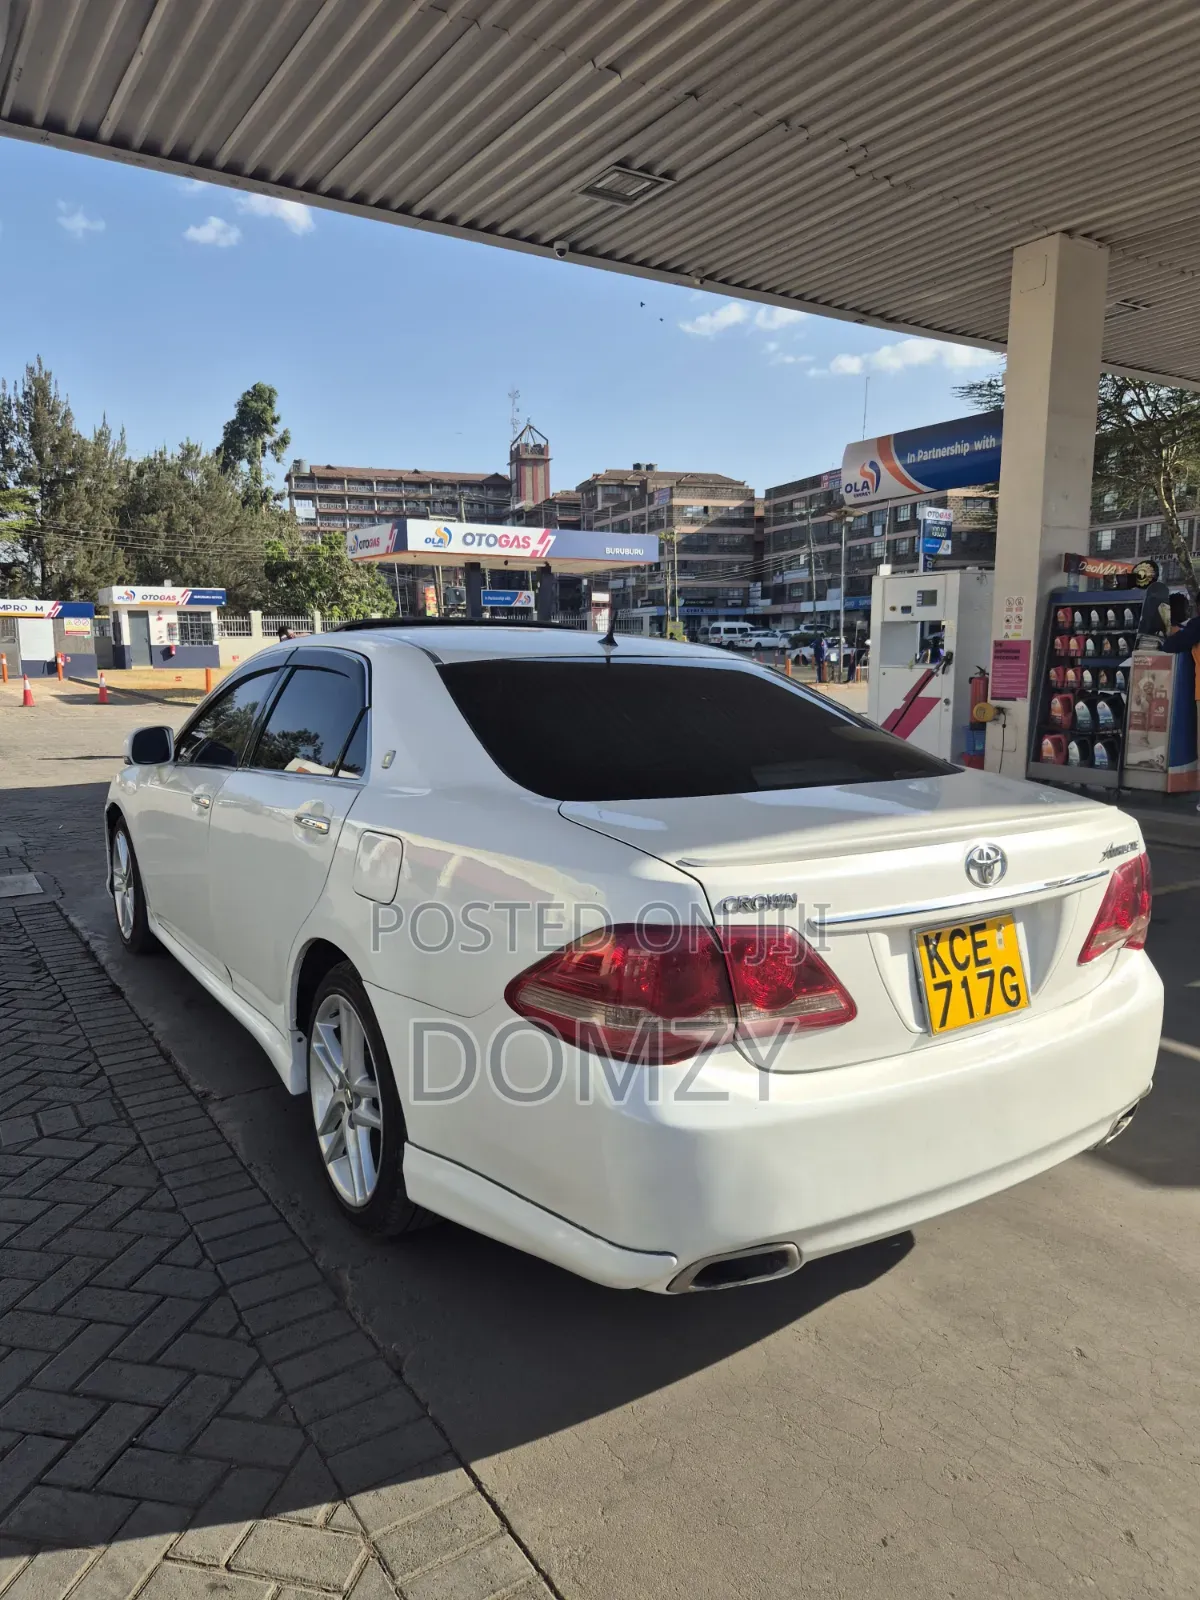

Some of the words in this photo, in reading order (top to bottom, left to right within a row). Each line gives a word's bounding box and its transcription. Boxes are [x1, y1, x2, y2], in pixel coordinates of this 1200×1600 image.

[907, 452, 915, 463] In
[917, 440, 970, 463] Partnership
[974, 435, 996, 451] with
[844, 480, 870, 494] OLA
[927, 511, 952, 519] OTOGAS
[359, 537, 380, 550] OTOGAS
[424, 537, 444, 545] OLA
[462, 532, 532, 549] OTOGAS
[605, 547, 644, 556] BURUBURU
[716, 893, 798, 915] CROWN
[922, 922, 992, 979] KCE
[933, 965, 1021, 1028] 717G
